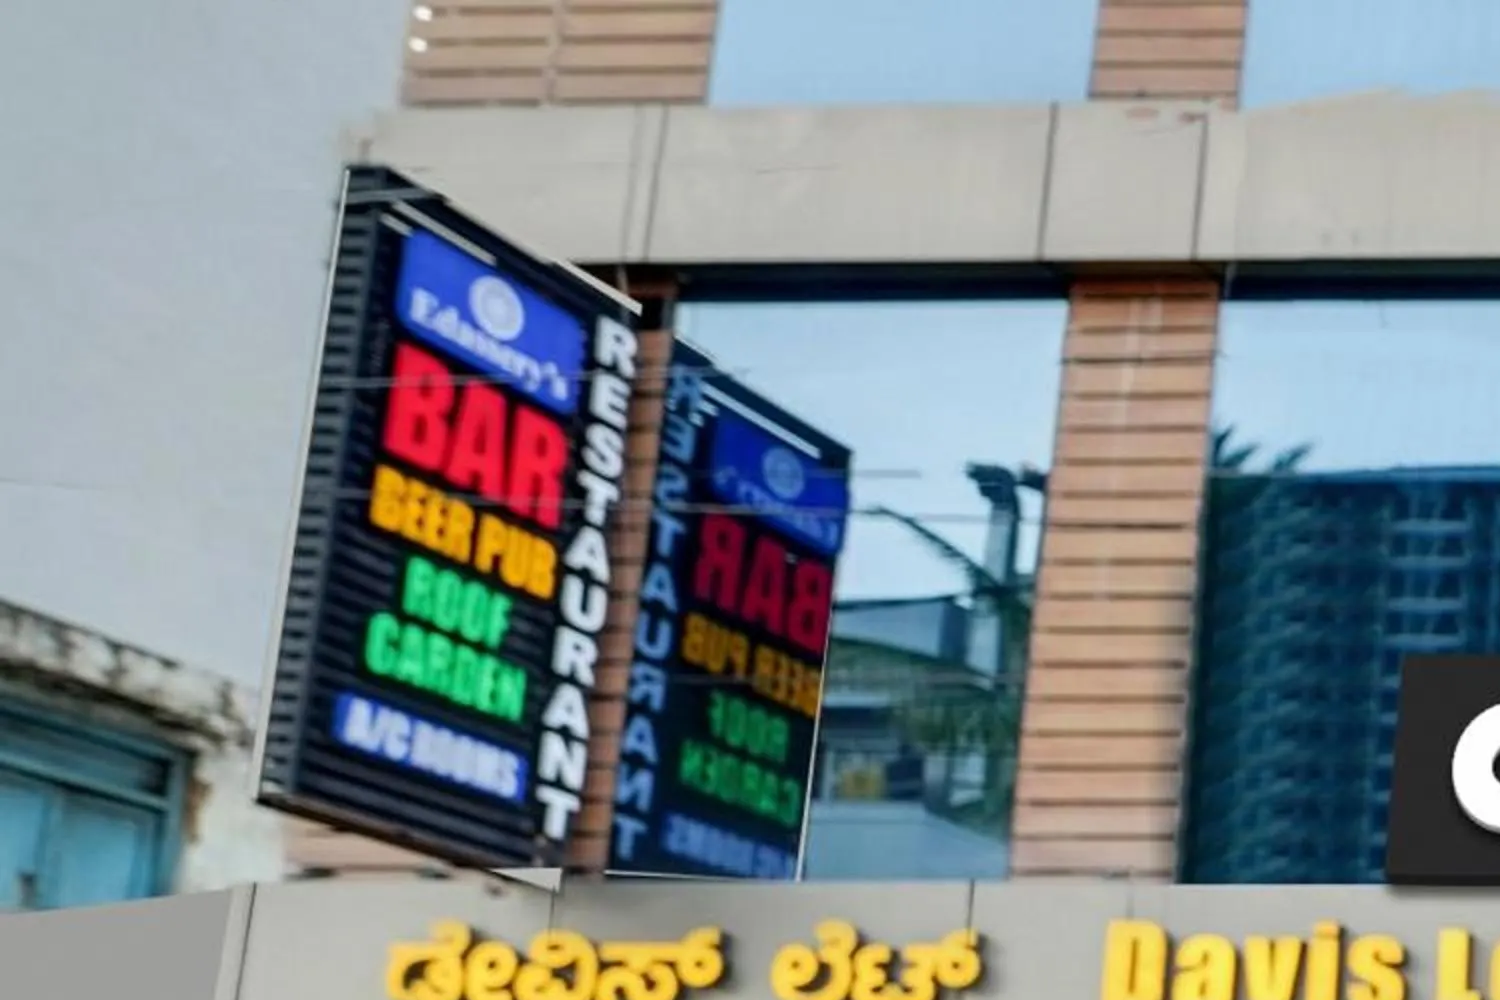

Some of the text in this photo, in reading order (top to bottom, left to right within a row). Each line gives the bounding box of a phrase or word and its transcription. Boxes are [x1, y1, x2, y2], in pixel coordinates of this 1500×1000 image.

[384, 340, 567, 529] BAR
[370, 464, 558, 601] BEER PUB
[536, 313, 636, 839] RESTAURANT
[364, 611, 527, 723] GARDEN
[403, 556, 511, 650] ROOF
